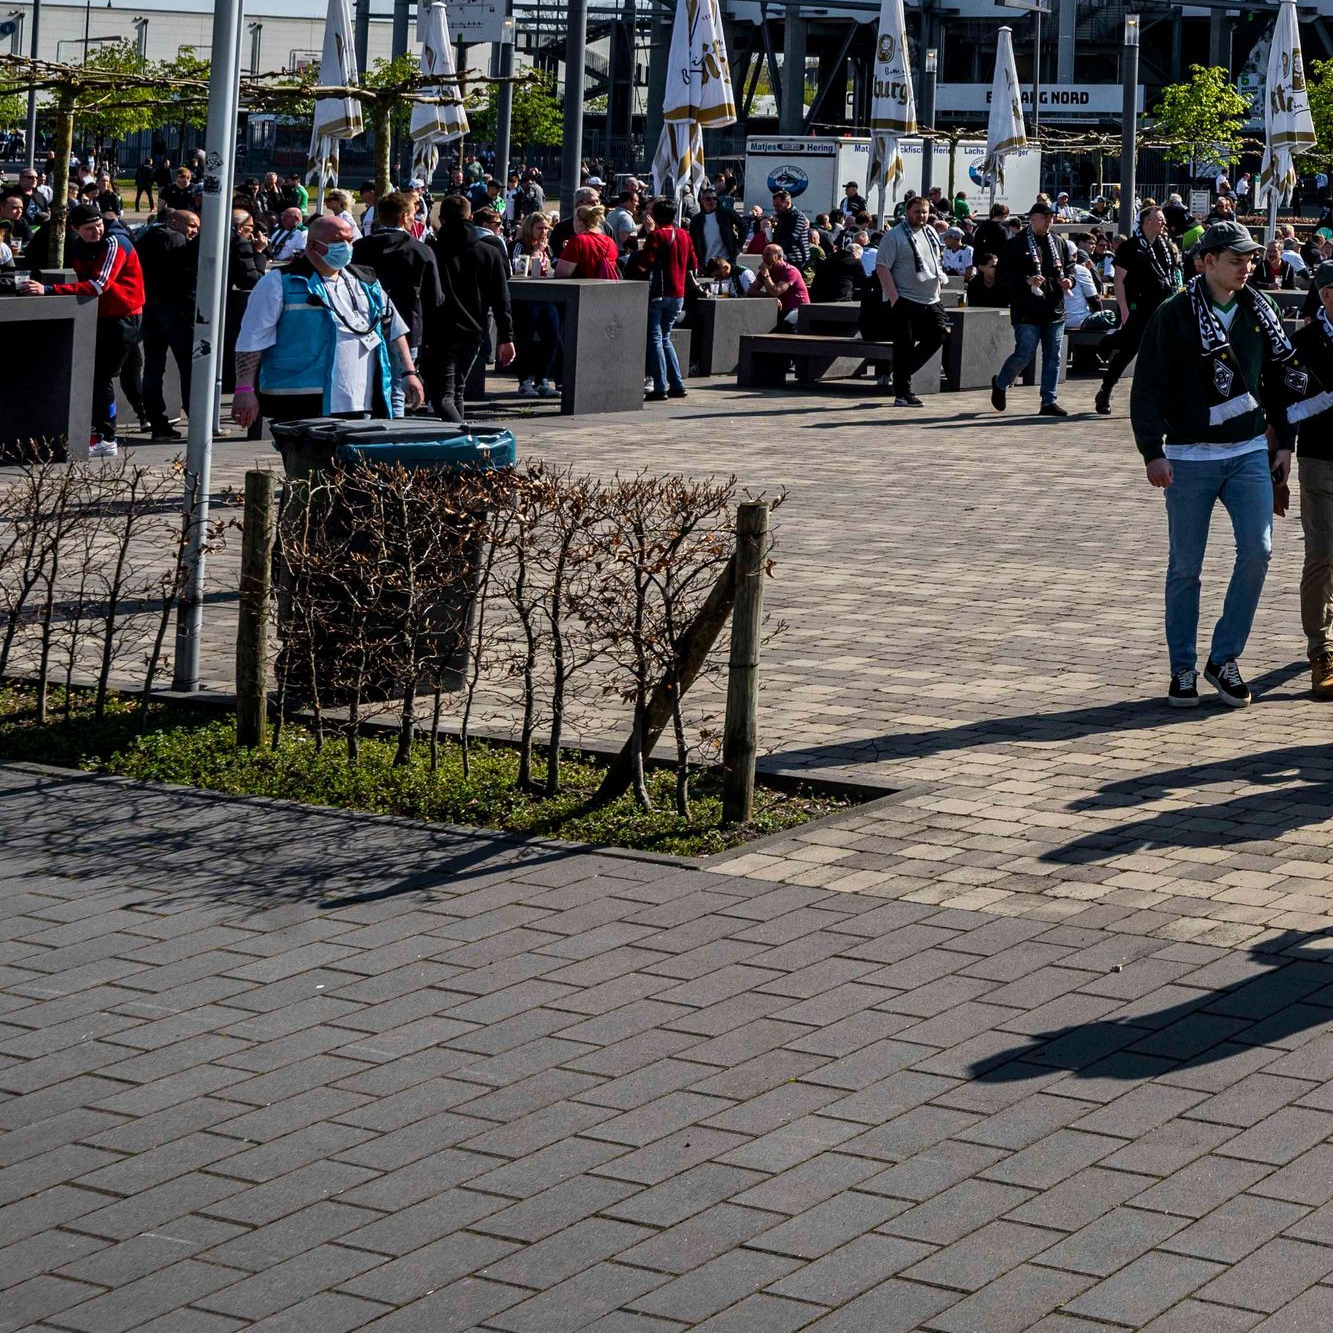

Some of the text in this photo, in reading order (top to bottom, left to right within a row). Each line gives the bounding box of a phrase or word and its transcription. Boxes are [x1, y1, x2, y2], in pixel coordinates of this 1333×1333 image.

[1051, 91, 1090, 105] NORD
[750, 142, 777, 152] Matjes
[807, 143, 834, 153] Hering
[964, 146, 984, 155] Lachs
